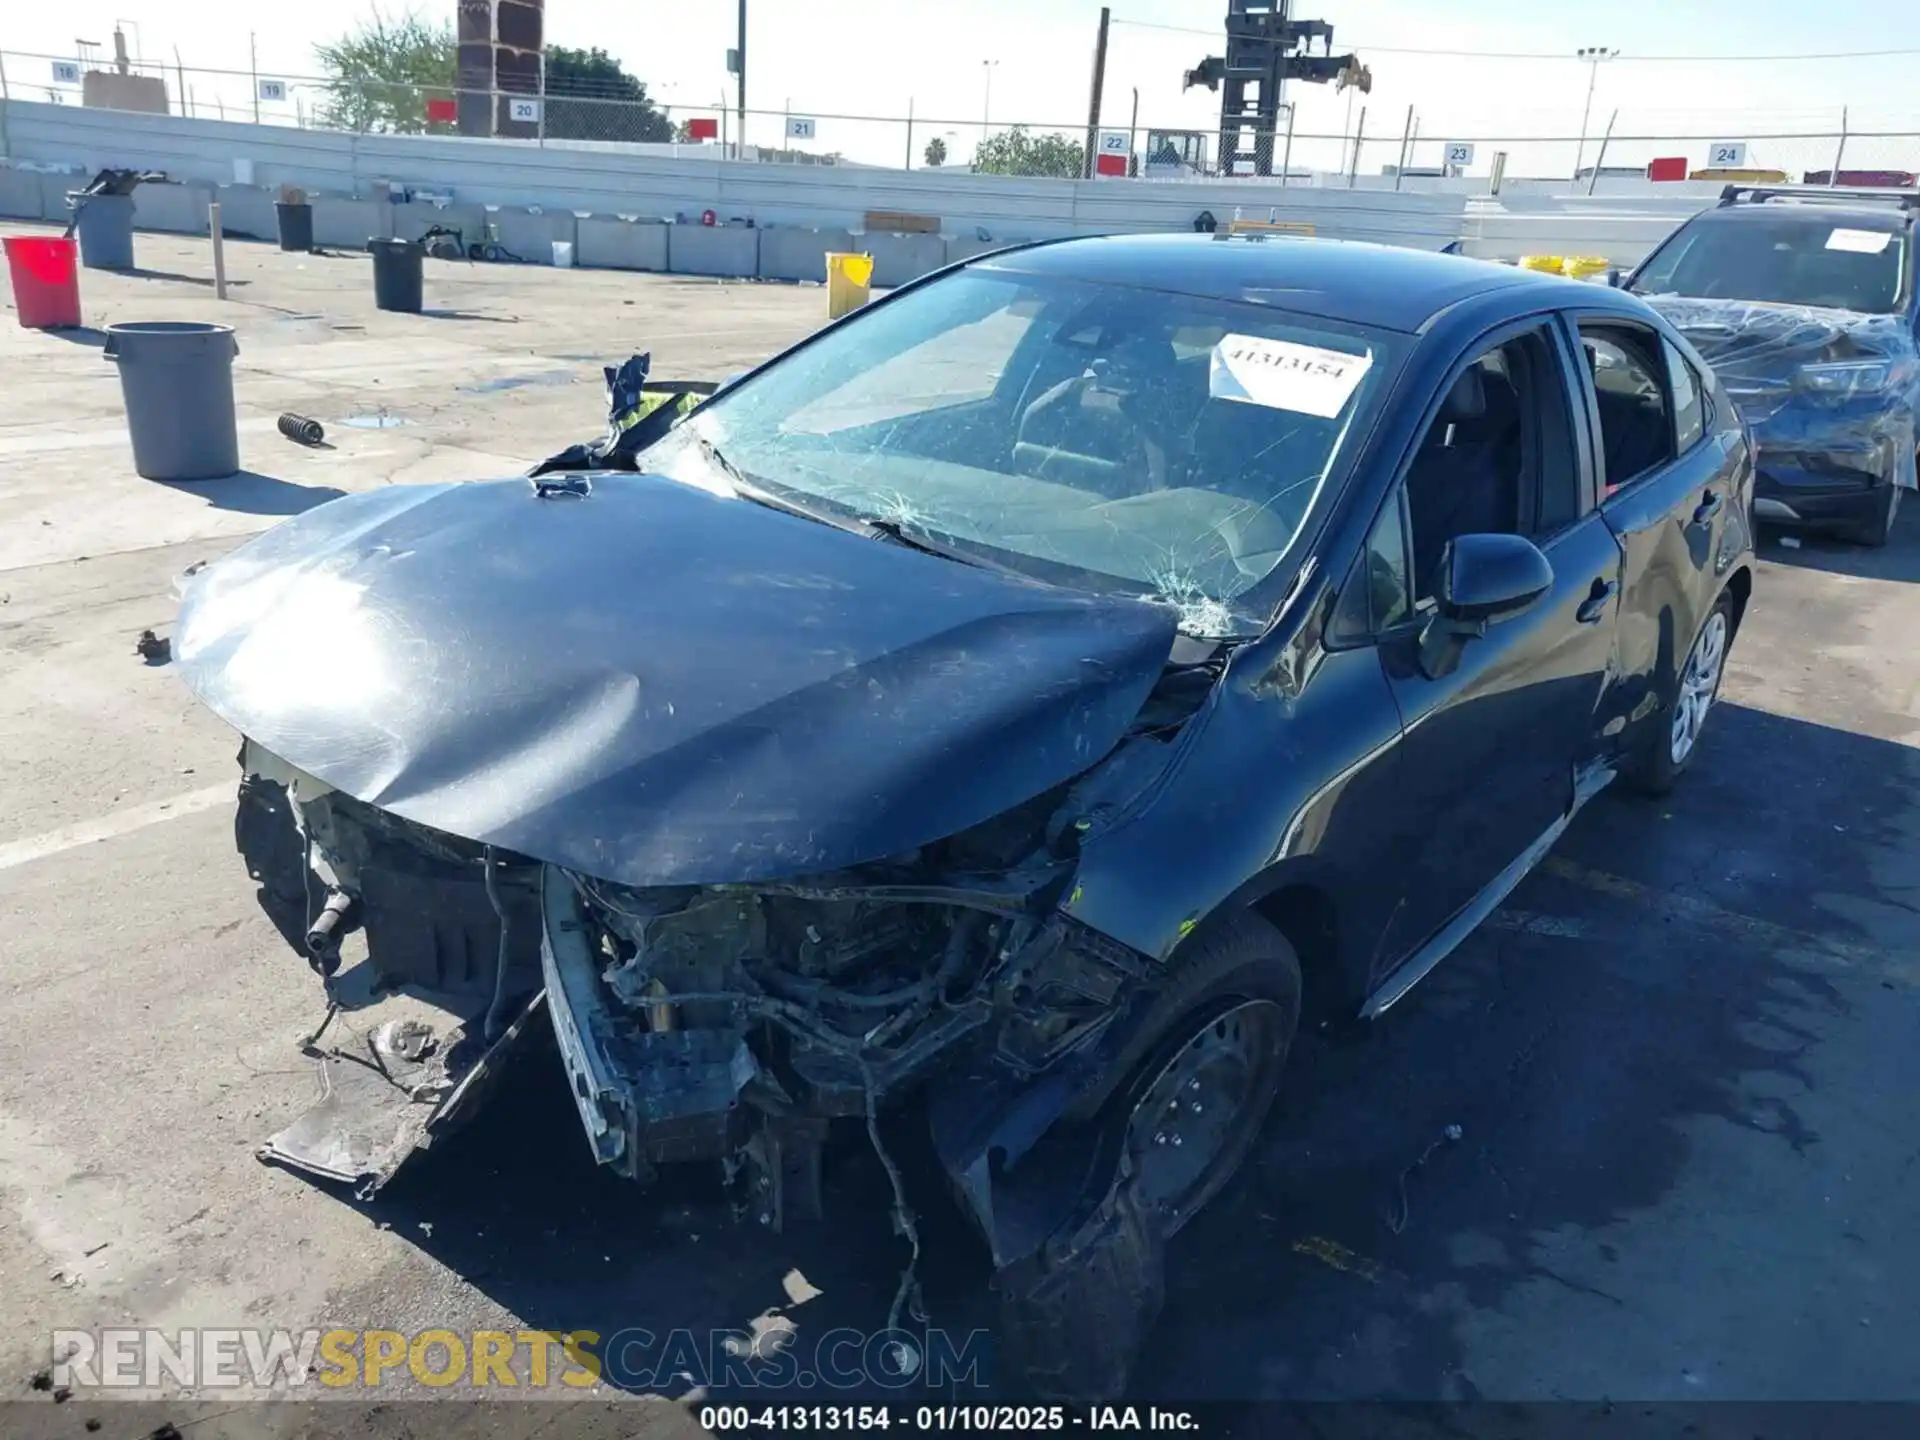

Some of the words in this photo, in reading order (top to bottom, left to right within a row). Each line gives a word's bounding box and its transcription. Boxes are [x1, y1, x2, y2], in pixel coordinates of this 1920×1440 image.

[266, 85, 280, 97] 19
[517, 105, 532, 116] 20
[794, 123, 809, 135] 21
[1107, 137, 1122, 149] 22
[1450, 148, 1467, 160] 23
[1717, 149, 1736, 162] 24
[1228, 348, 1345, 379] 41313154
